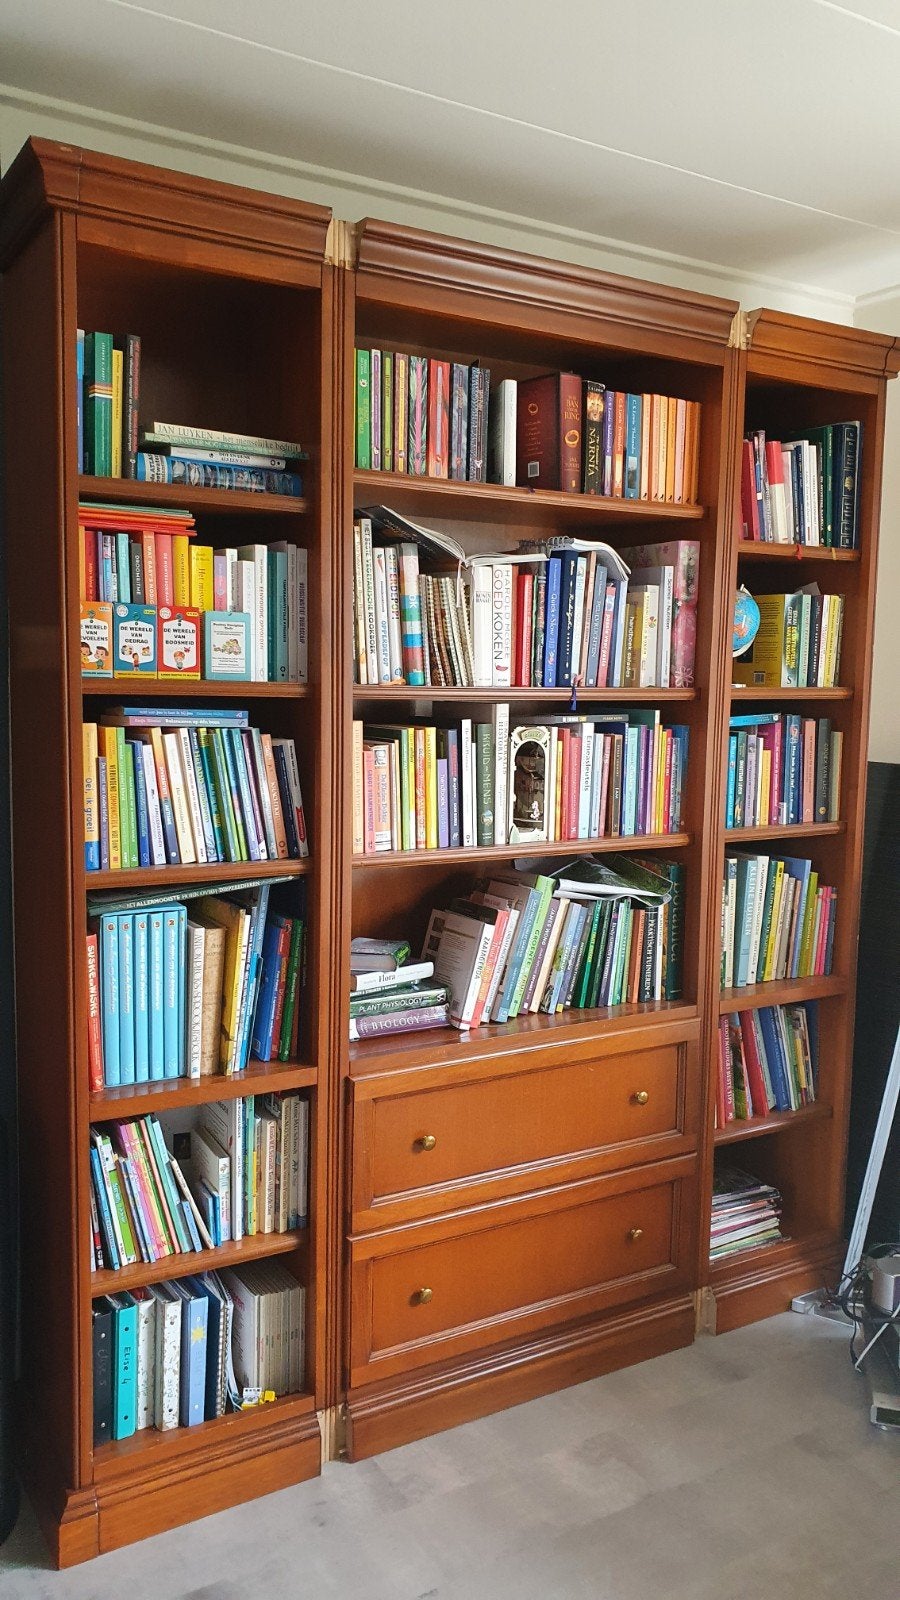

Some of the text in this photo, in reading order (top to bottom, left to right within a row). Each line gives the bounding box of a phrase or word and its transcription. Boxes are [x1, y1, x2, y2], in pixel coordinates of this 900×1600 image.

[157, 424, 175, 436] JAN
[178, 427, 214, 439] LUYKEN
[587, 428, 596, 476] NARNIA
[390, 554, 398, 620] OPPERDEPOP!
[494, 570, 502, 659] GOED KOKEN
[625, 653, 633, 678] salades
[110, 765, 118, 792] VERBINDEND
[483, 733, 492, 805] KRUID MENS
[85, 778, 93, 793] Oei,
[84, 808, 94, 832] groei!
[137, 895, 181, 907] ALLERMOOISTE
[745, 866, 757, 935] KLEINE TUINEN
[542, 908, 556, 945] JAMES WONG
[647, 919, 655, 955] PRAKTISCH
[526, 929, 540, 965] GROENTE
[88, 945, 98, 1017] SUSKE WISKE
[378, 974, 395, 982] Flora
[359, 998, 423, 1012] PLANT PHYSIOLOGY
[372, 1016, 422, 1030] BIOLOGY
